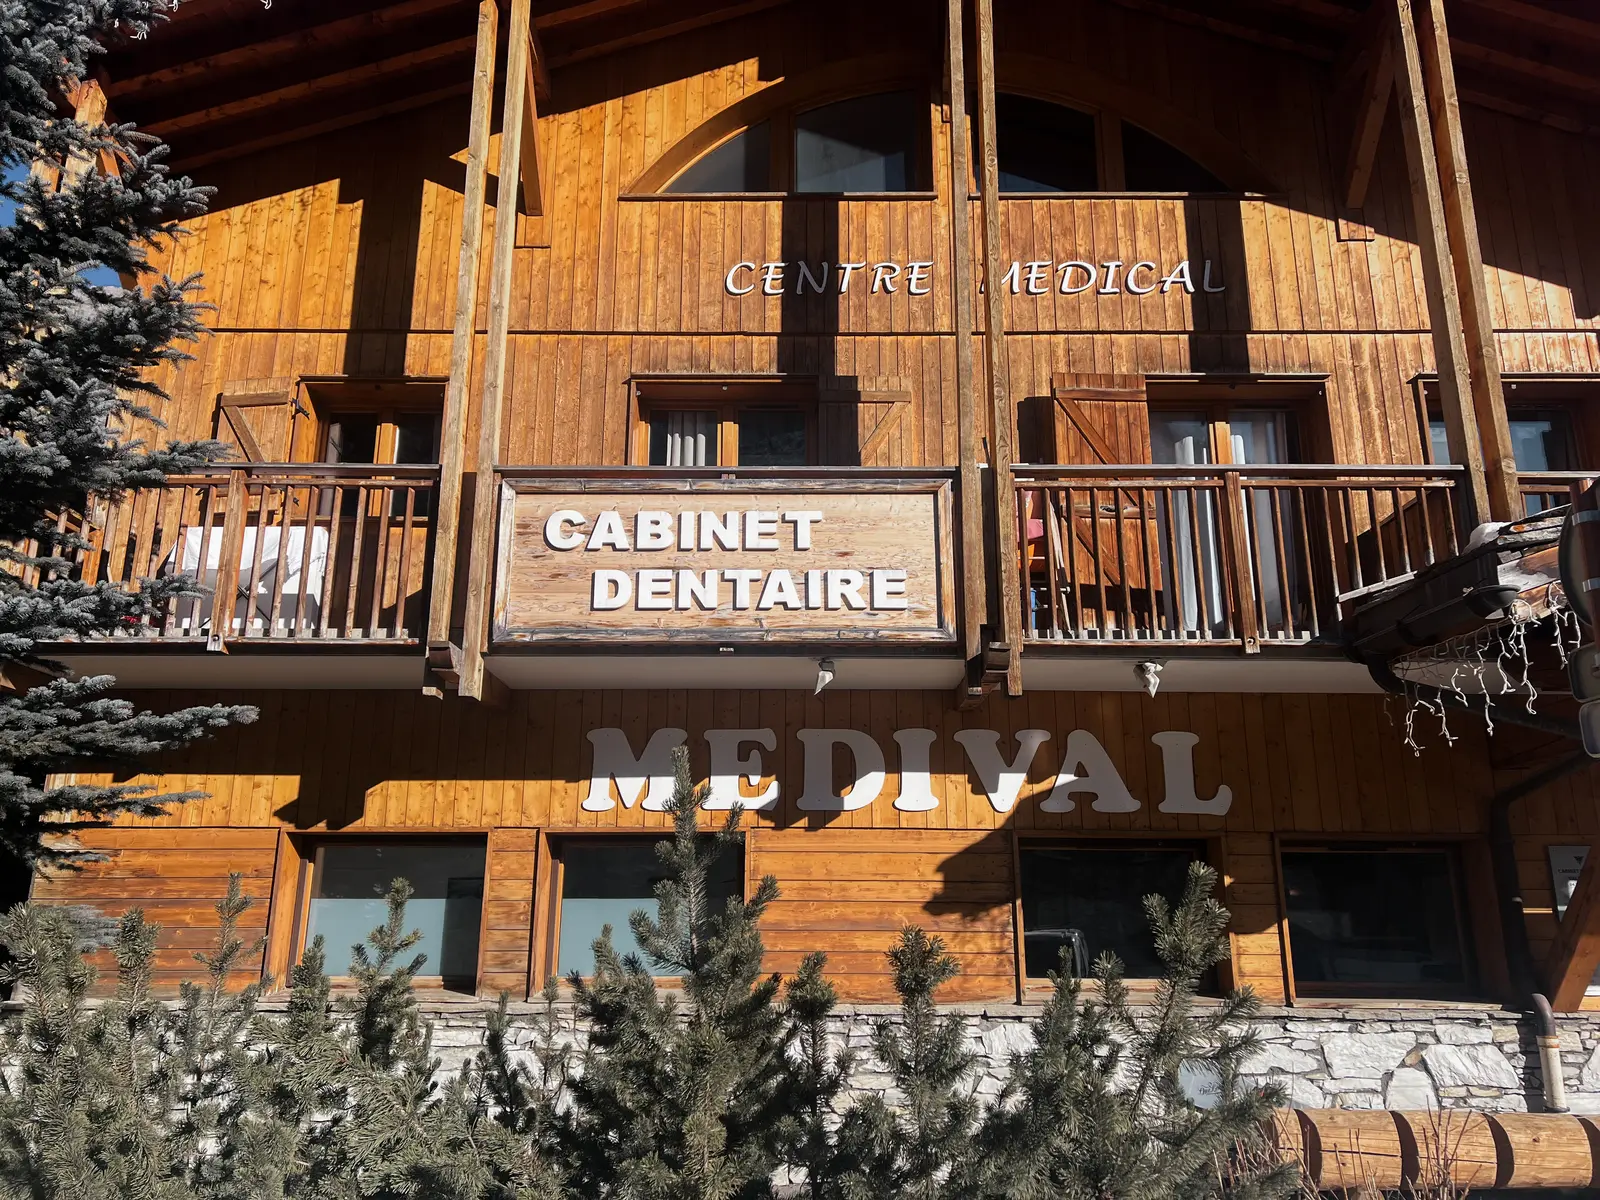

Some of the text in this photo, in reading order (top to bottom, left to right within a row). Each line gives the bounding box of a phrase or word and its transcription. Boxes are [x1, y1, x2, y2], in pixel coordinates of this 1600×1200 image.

[724, 261, 934, 296] CENTRE
[544, 509, 823, 551] CABINET
[591, 569, 909, 611] DENTAIRE
[581, 727, 1233, 815] MEDIVAL
